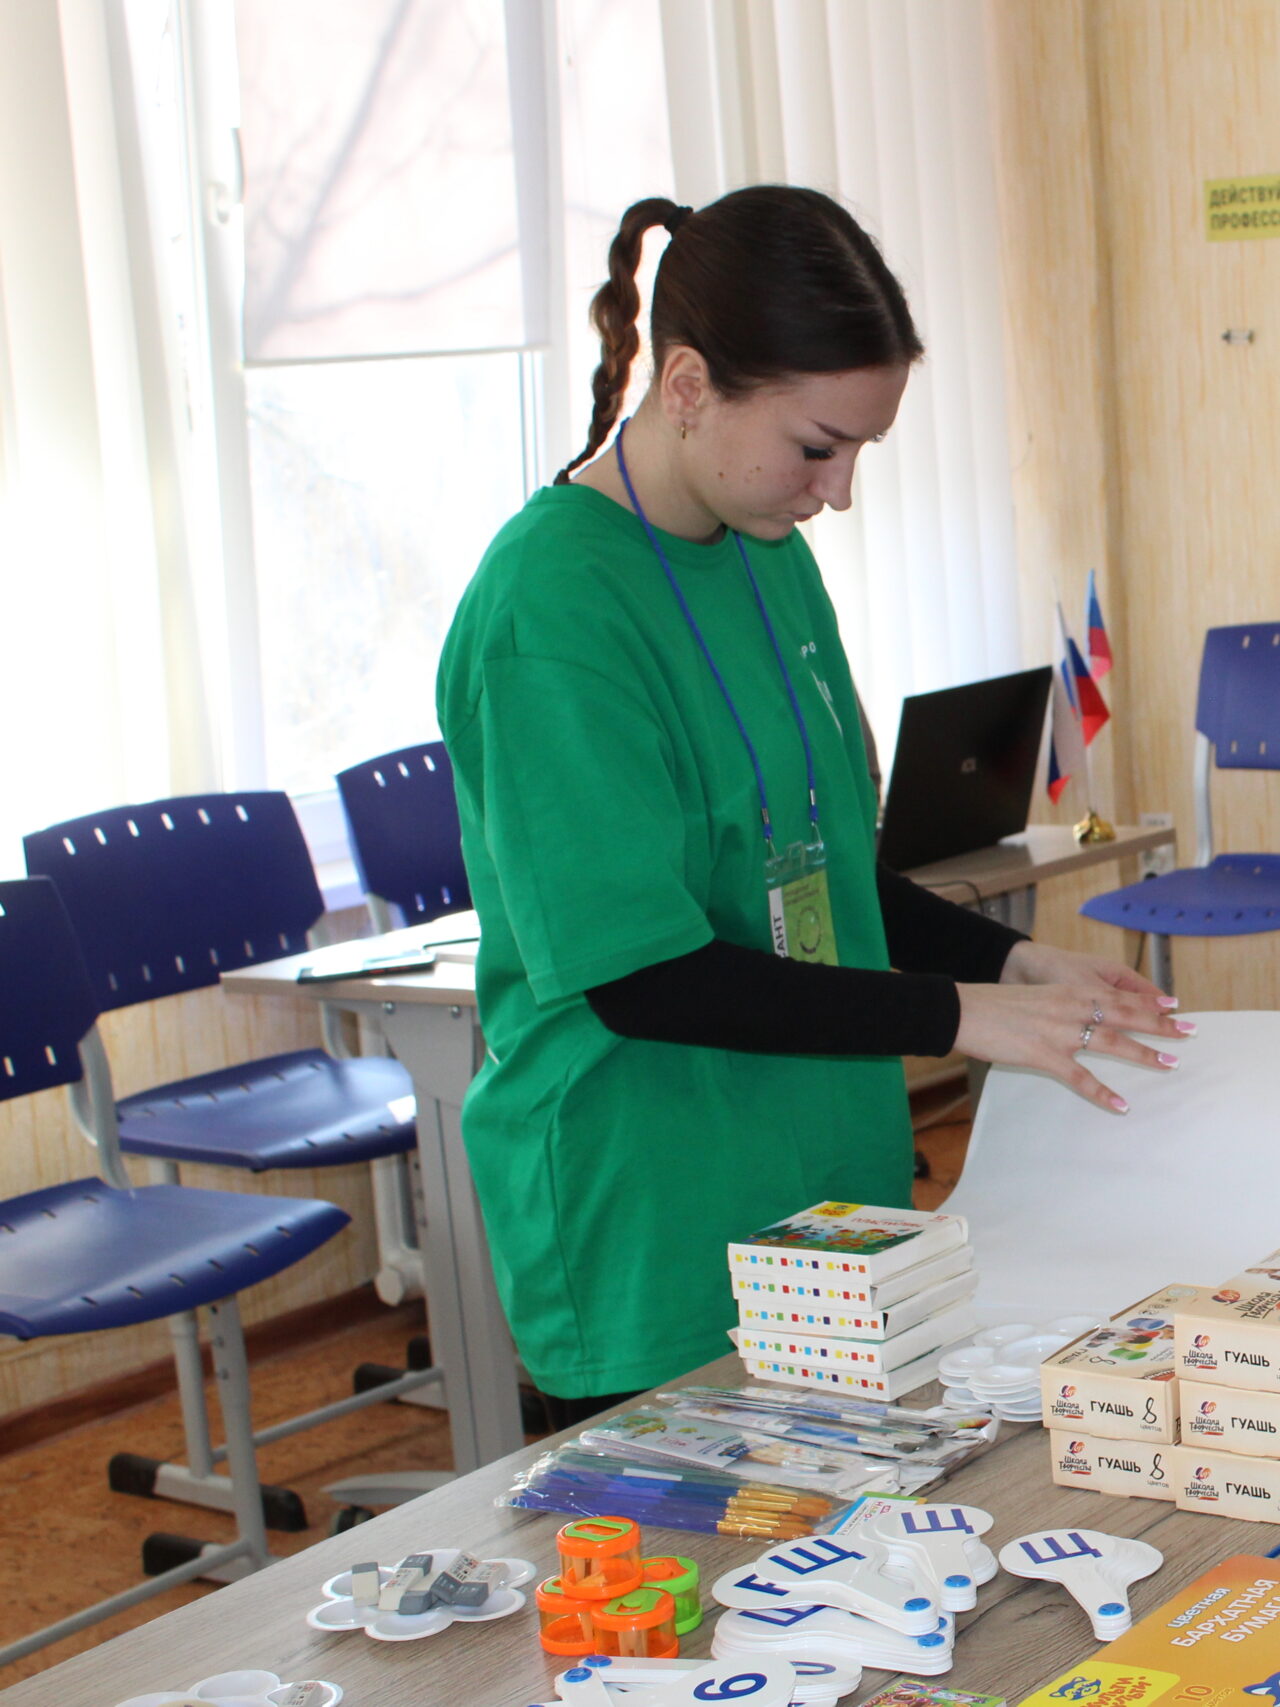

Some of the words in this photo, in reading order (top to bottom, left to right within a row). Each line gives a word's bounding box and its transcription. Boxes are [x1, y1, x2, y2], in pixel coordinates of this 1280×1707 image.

[1224, 1350, 1270, 1367] ГУАШЬ
[1090, 1400, 1134, 1417] ГУАШЬ
[1231, 1417, 1277, 1433] ГУАШЬ
[1098, 1456, 1141, 1473] ГУАШЬ
[1225, 1482, 1271, 1499] ГУАШЬ
[1019, 1532, 1103, 1564] Щ
[1168, 1588, 1232, 1628] цветная
[1170, 1579, 1279, 1647] БАРХАТНАЯ
[1174, 1685, 1213, 1701] 10
